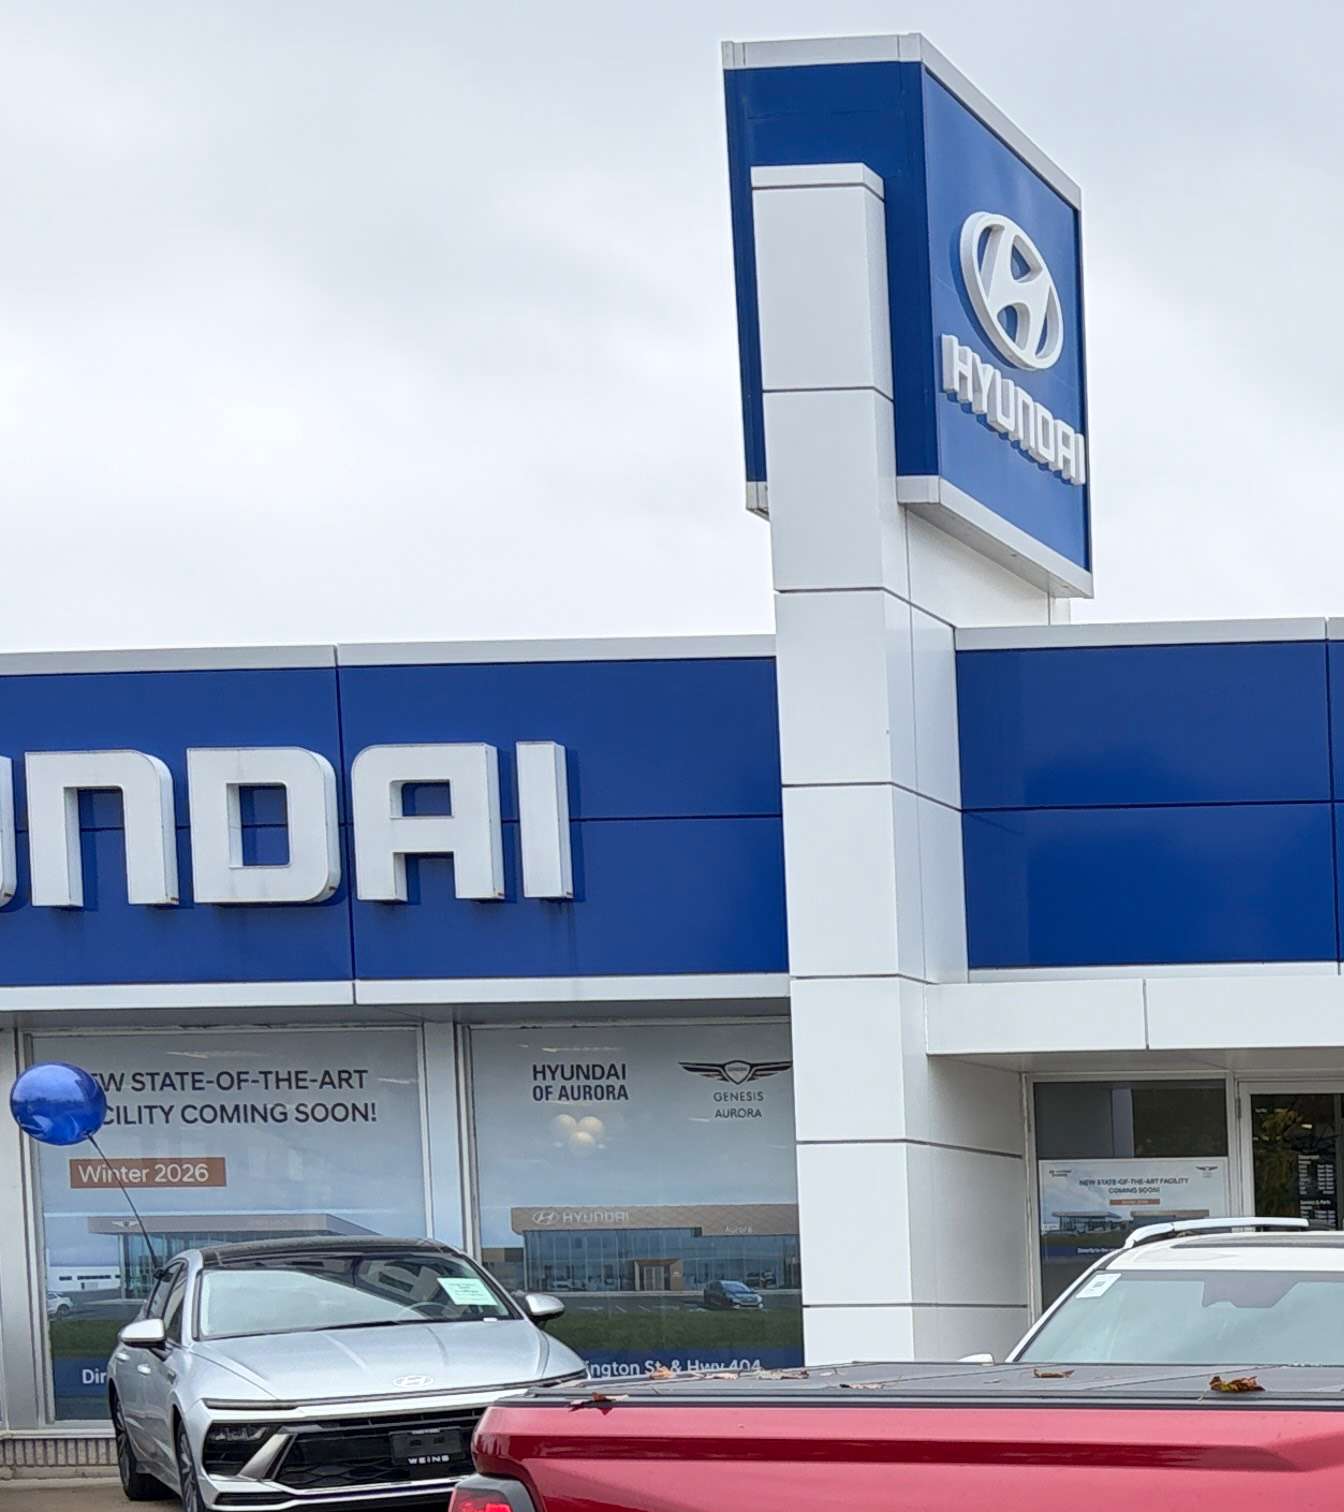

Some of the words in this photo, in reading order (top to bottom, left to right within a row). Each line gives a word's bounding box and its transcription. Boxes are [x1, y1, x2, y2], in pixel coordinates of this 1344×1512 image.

[942, 333, 1085, 485] HYUNDAI
[0, 741, 574, 908] NDAI
[130, 1069, 368, 1092] STATE-OF-THE-ART
[532, 1063, 626, 1081] HYUNDAI
[532, 1085, 553, 1101] OF
[558, 1084, 628, 1101] AURORA
[713, 1091, 764, 1102] GENESIS
[104, 1104, 175, 1125] CILITY
[181, 1103, 288, 1125] COMING
[295, 1102, 377, 1123] SOON!
[714, 1108, 762, 1119] AURORA
[78, 1164, 150, 1183] Winter
[154, 1163, 209, 1183] 2026
[562, 1211, 629, 1223] HYUNDAI
[82, 1368, 107, 1384] Dir
